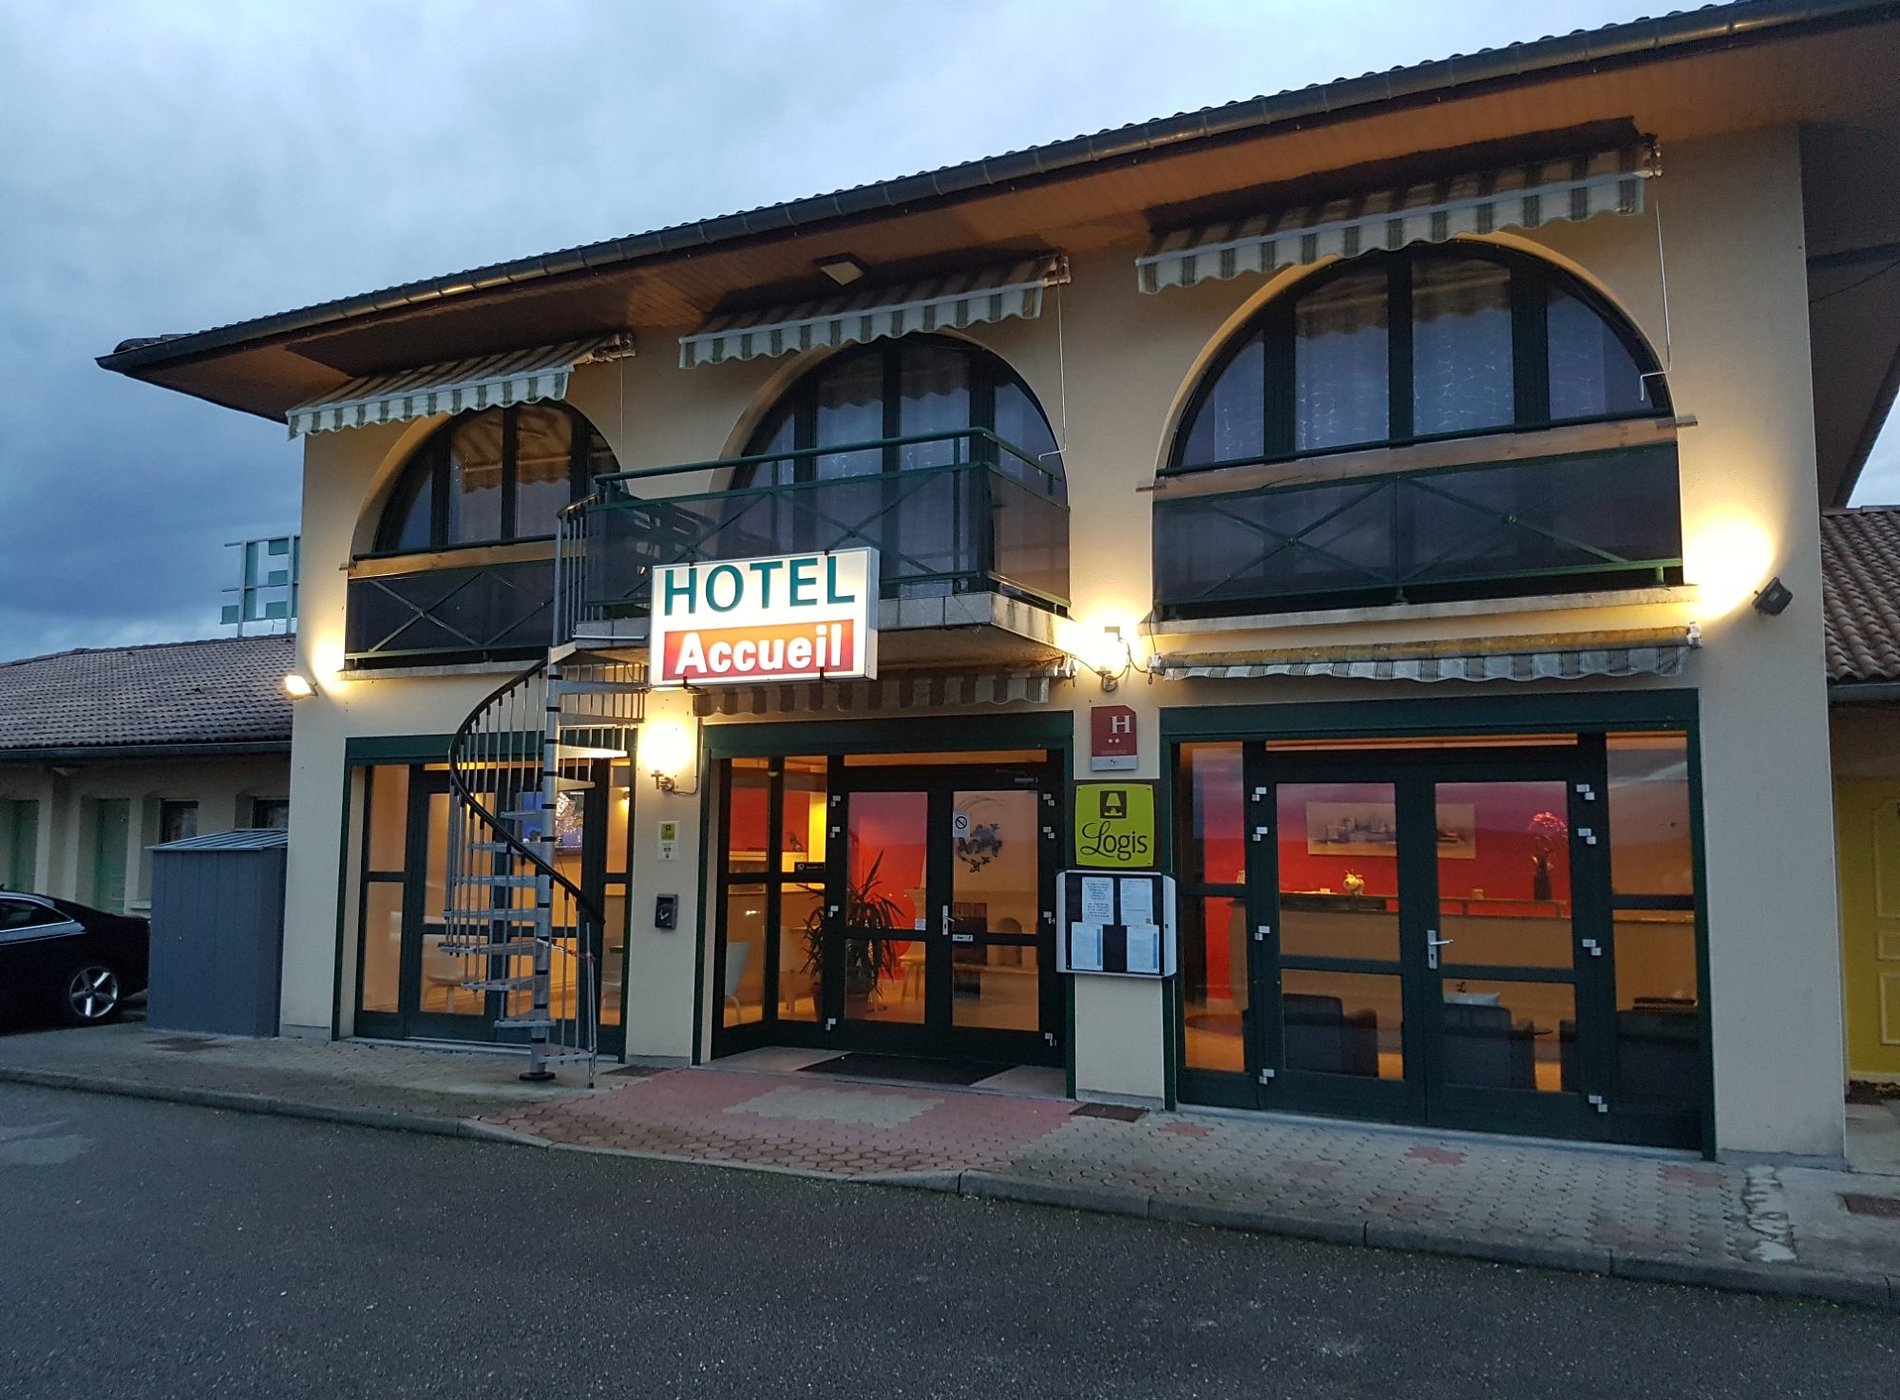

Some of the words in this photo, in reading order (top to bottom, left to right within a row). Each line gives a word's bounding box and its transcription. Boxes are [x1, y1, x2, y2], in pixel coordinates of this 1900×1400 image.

[664, 556, 855, 616] HOTEL
[674, 624, 843, 675] Accueil
[1111, 715, 1131, 734] H
[1081, 820, 1147, 861] Logis
